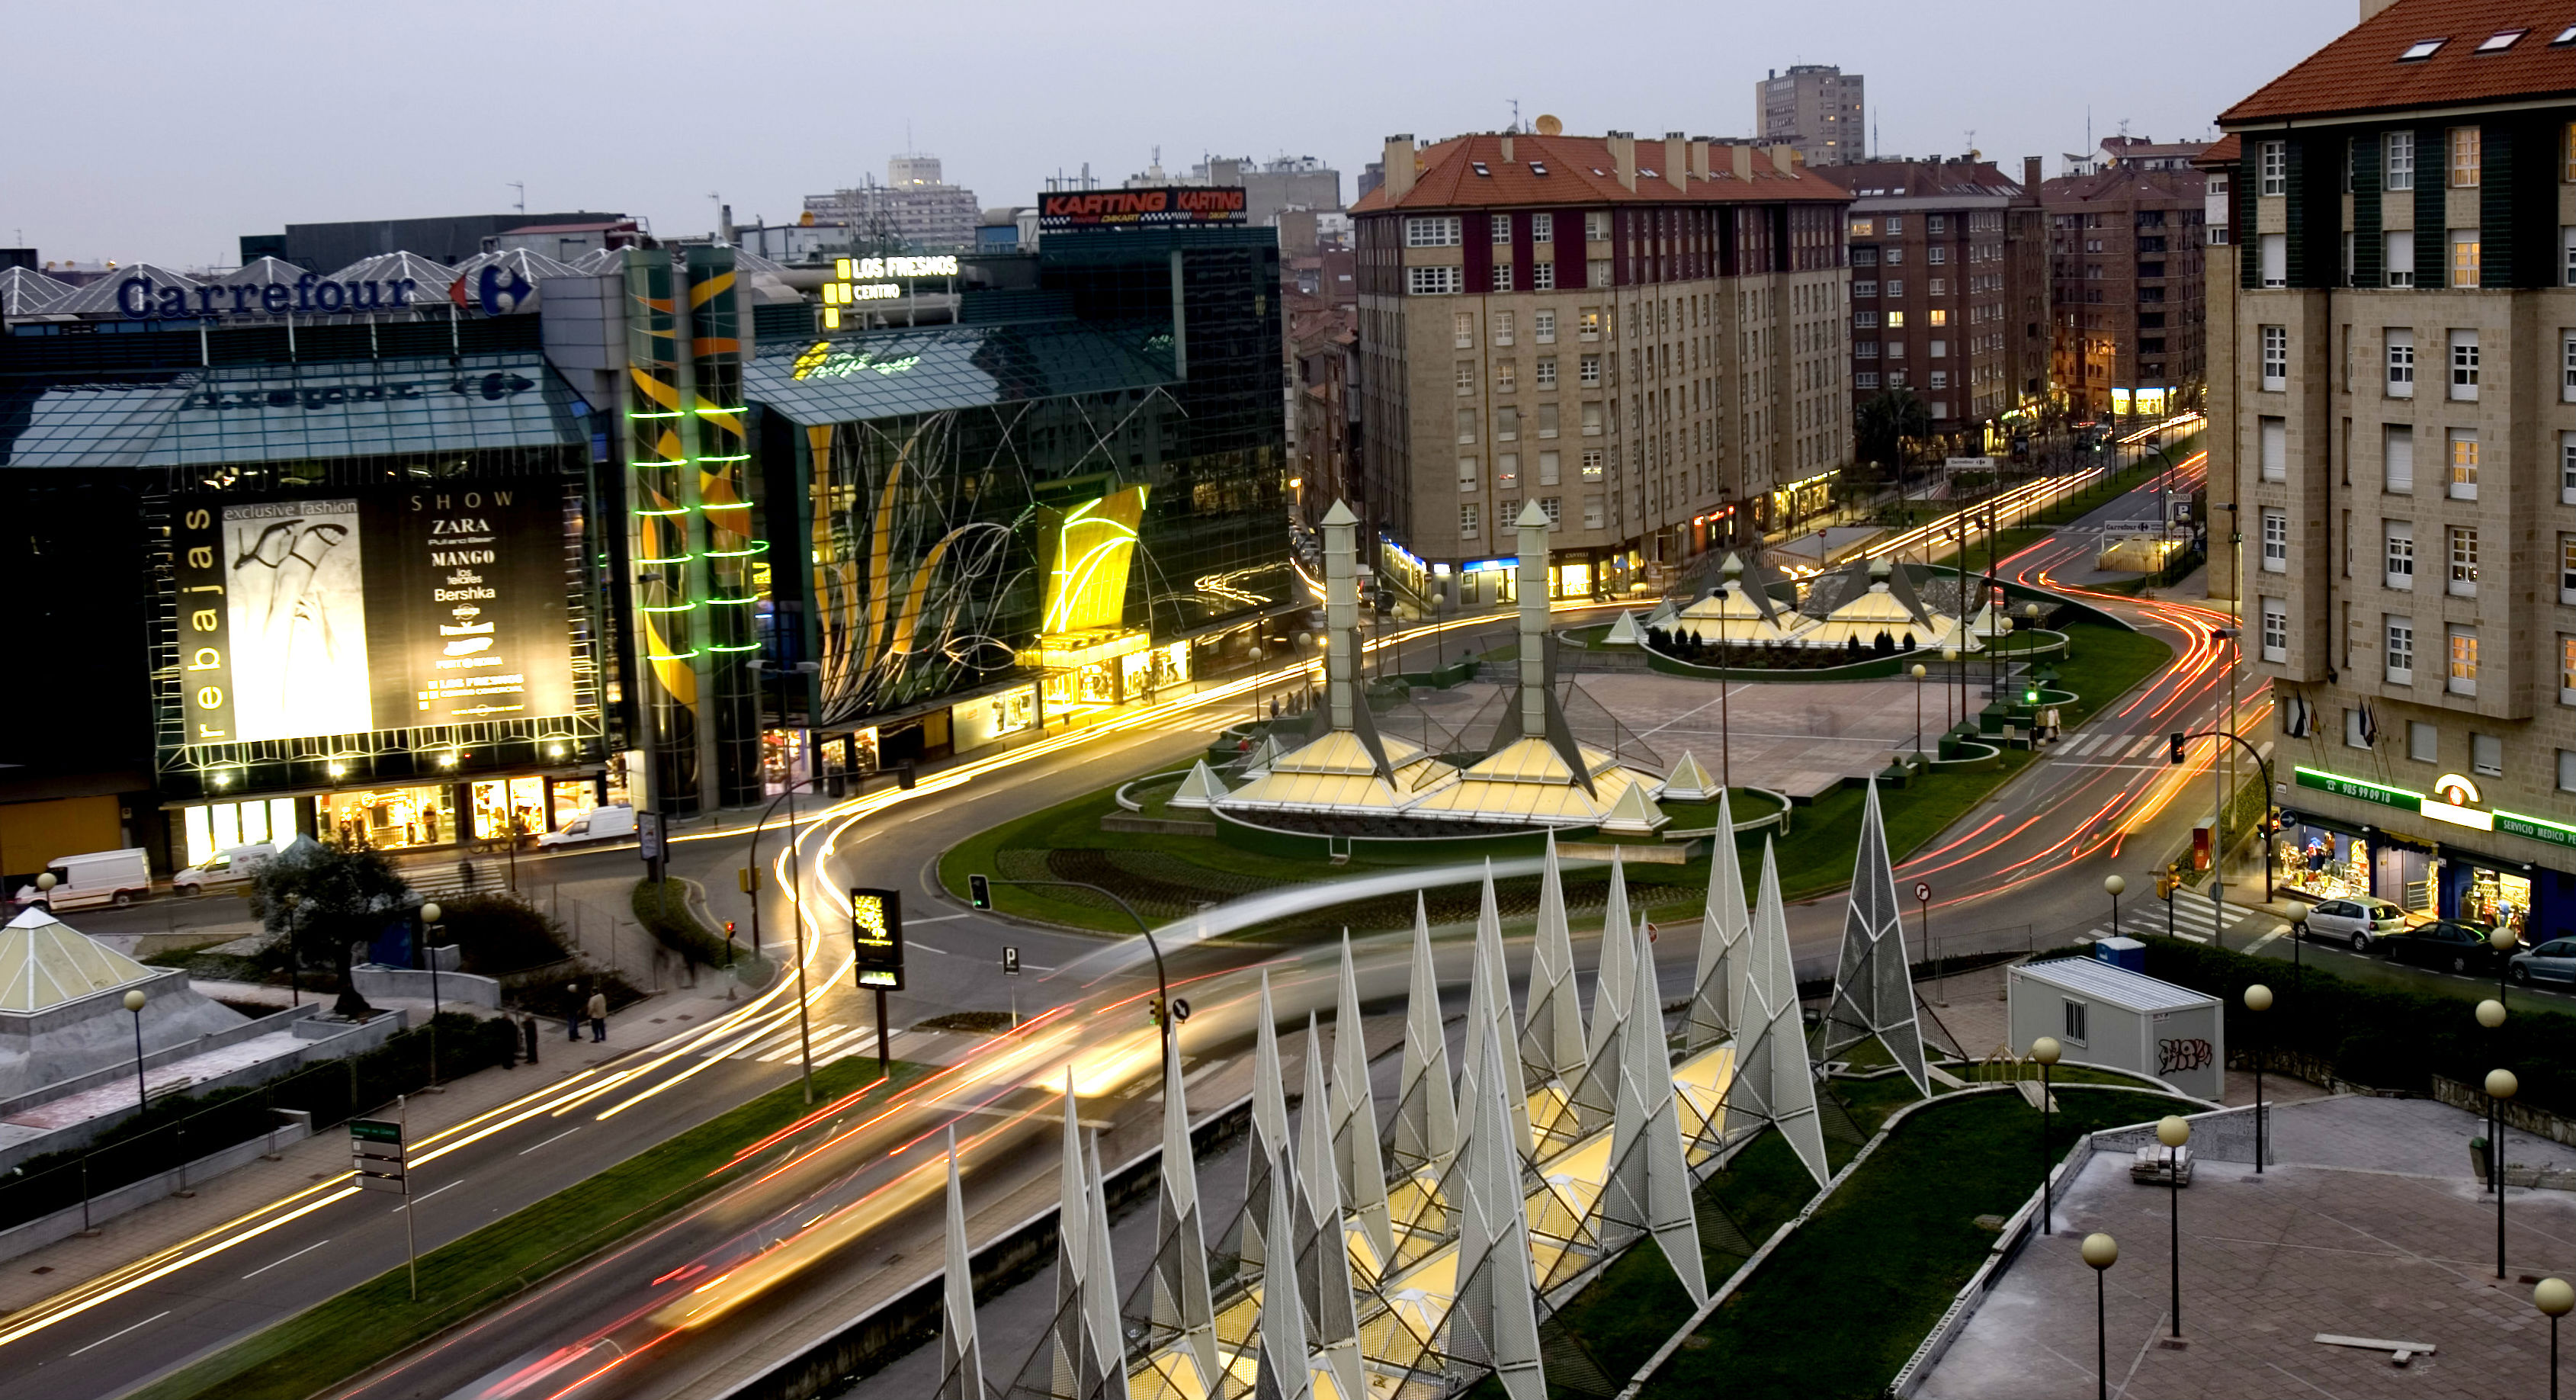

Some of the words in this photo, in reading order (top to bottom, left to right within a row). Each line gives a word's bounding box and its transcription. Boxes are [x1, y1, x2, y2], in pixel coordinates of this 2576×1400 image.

[1045, 192, 1167, 215] KARTING
[1177, 191, 1244, 210] KARTING
[852, 257, 884, 279] LOS
[887, 255, 958, 278] FRESNOS
[117, 272, 416, 320] Carrefour
[853, 283, 900, 300] CENTRO
[223, 504, 295, 520] exclusive
[300, 502, 358, 515] fashion
[411, 491, 513, 512] SHOW
[2177, 505, 2189, 516] P
[432, 518, 490, 535] ZARA
[431, 550, 496, 567] MANGO
[434, 586, 496, 602] Bershka
[183, 509, 226, 739] rebajas
[2343, 783, 2356, 795] 985
[2359, 786, 2368, 798] 99
[2369, 789, 2379, 801] 09
[2381, 792, 2391, 803] 18
[2504, 819, 2533, 835] SERVICIO
[2537, 827, 2565, 842] MEDICO
[1006, 948, 1015, 965] P
